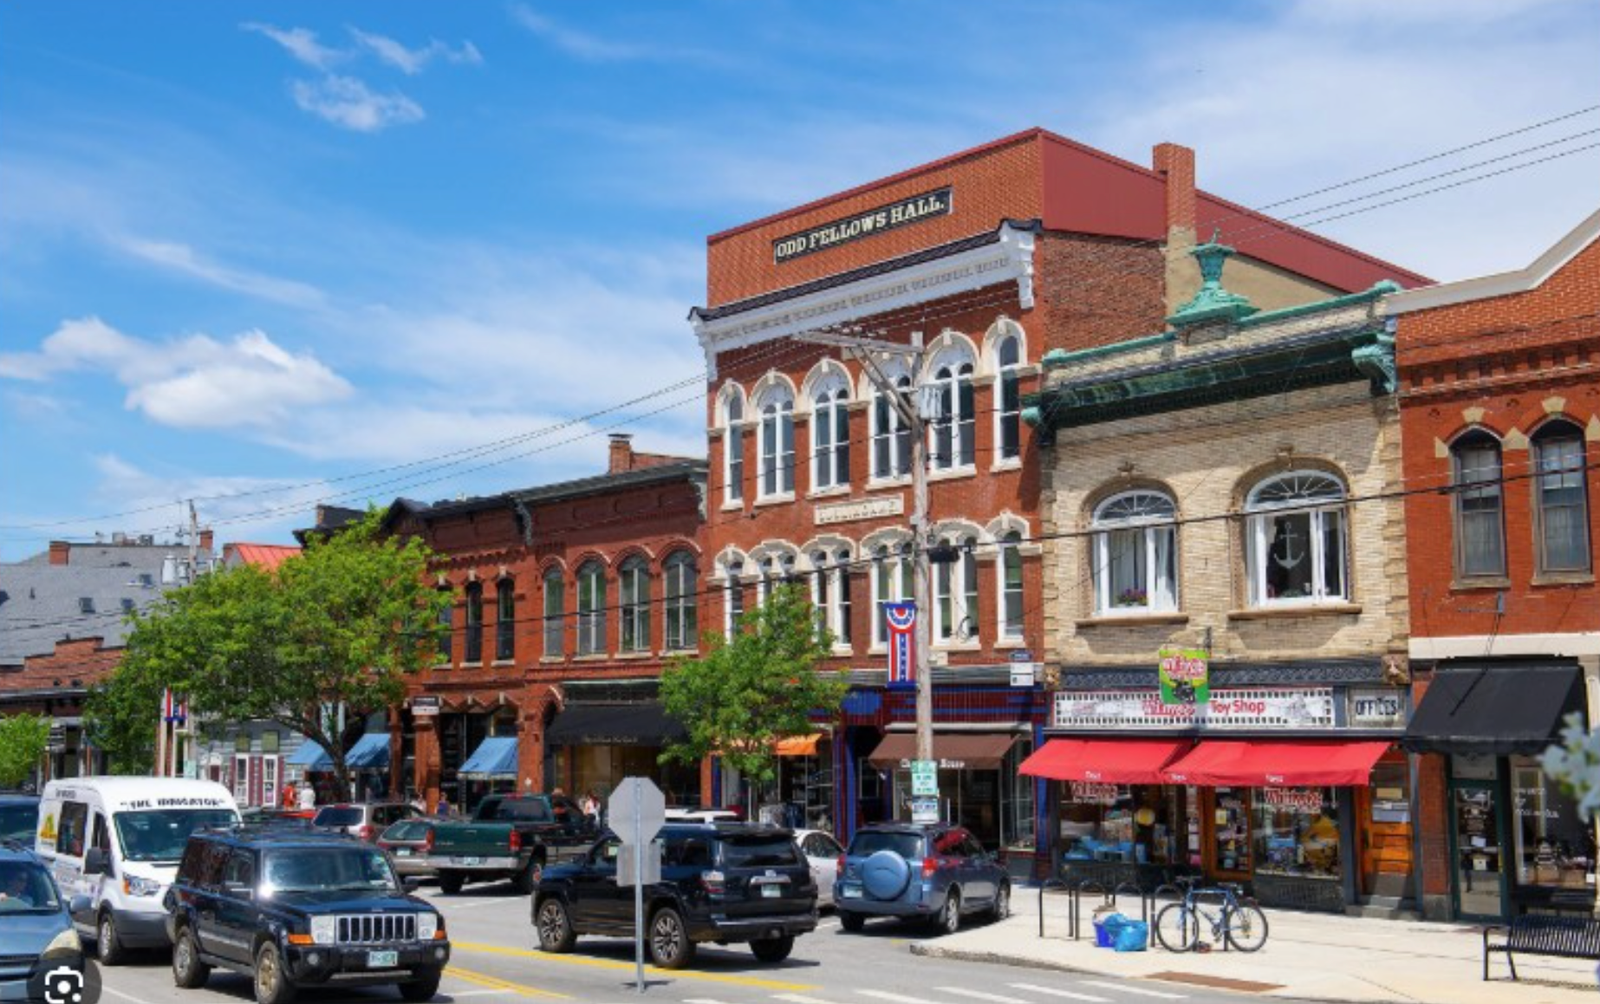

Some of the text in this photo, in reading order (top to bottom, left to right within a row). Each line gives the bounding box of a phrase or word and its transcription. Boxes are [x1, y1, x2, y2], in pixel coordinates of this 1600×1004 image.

[777, 196, 944, 257] ODD FELLOWS HALL.
[1209, 700, 1231, 715] Toy
[1233, 699, 1265, 716] Shop
